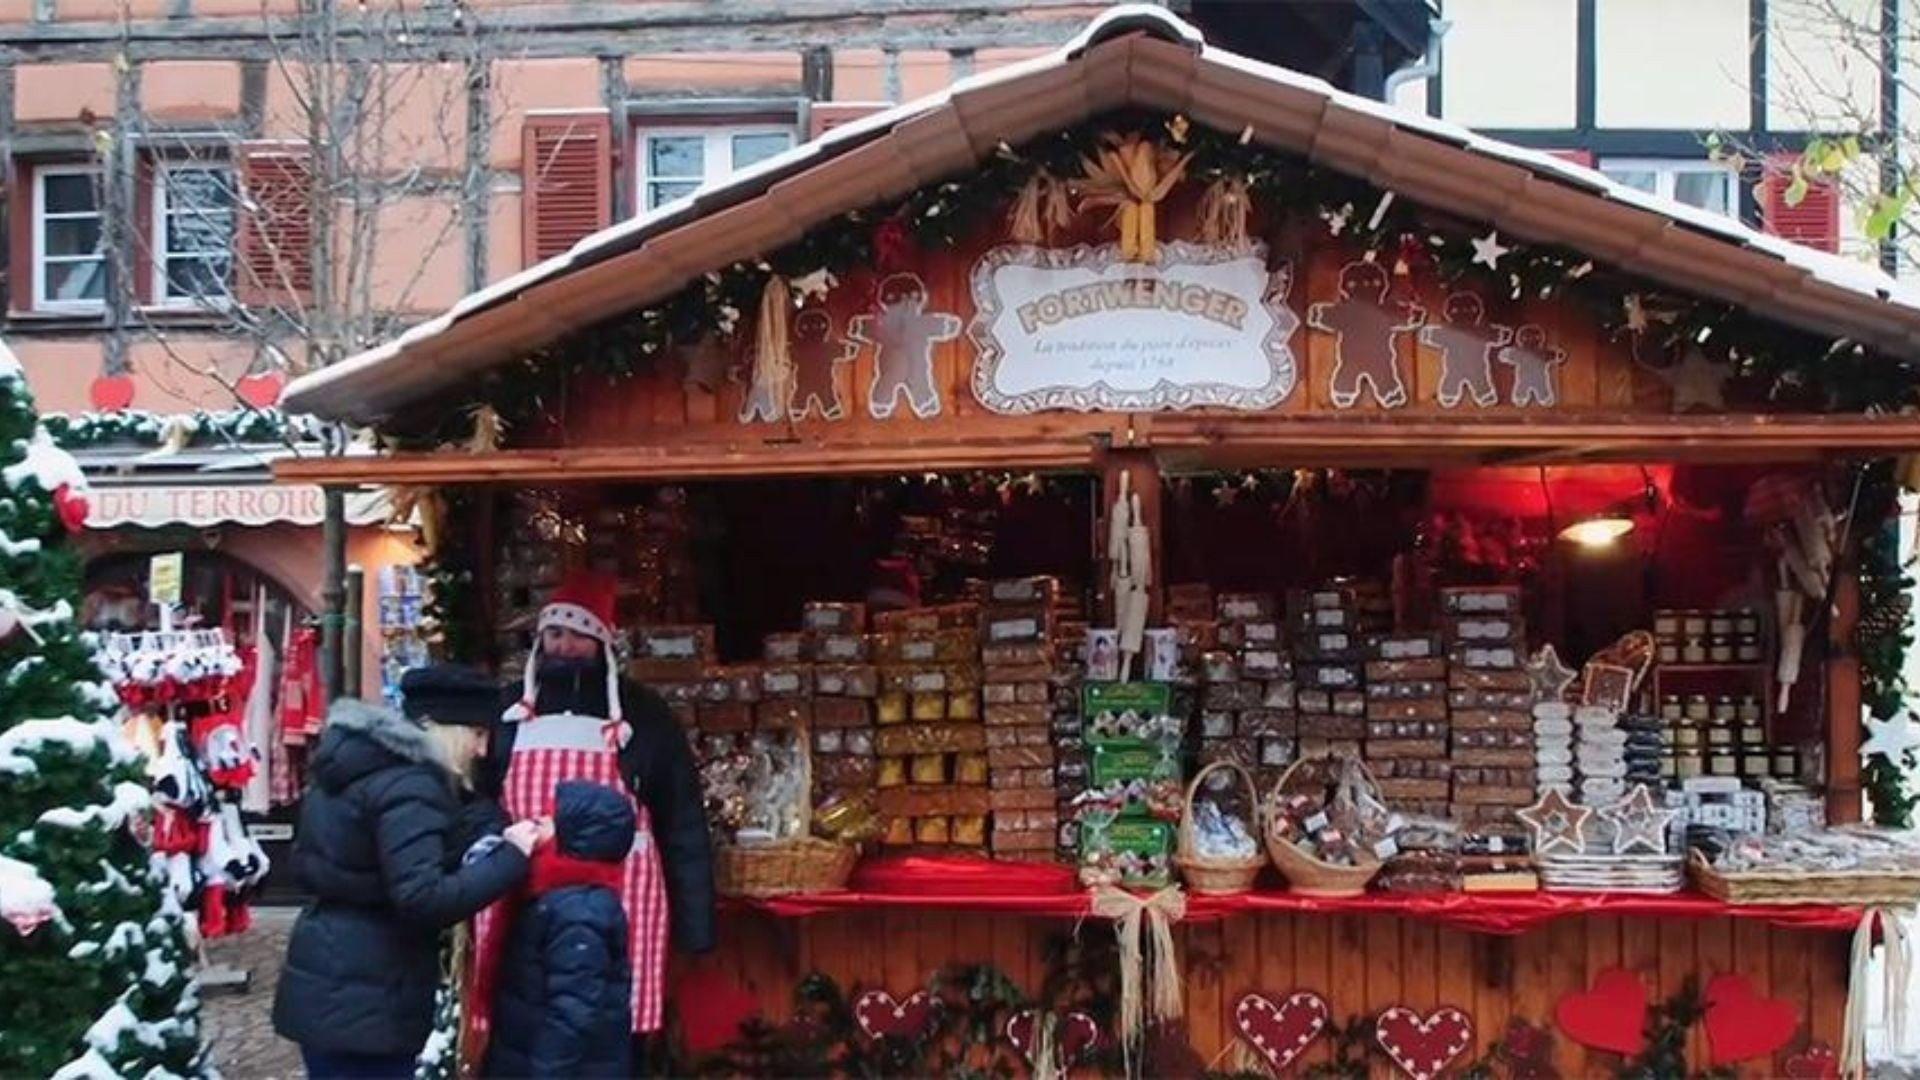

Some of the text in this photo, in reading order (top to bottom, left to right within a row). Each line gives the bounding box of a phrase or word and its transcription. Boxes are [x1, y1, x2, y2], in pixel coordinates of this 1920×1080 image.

[1016, 278, 1249, 334] FORTWENGER
[99, 488, 319, 520] DU TERROIR
